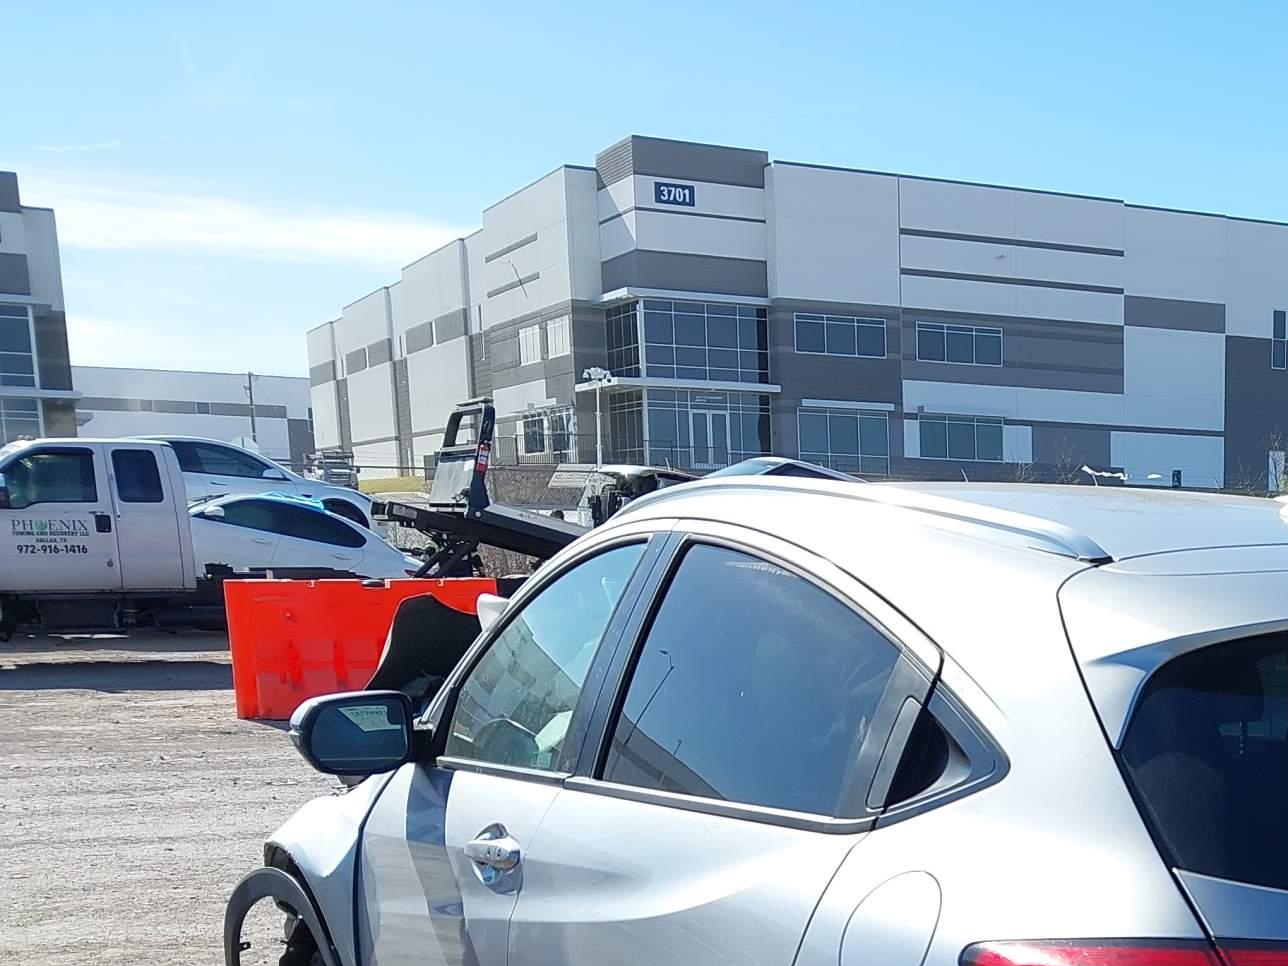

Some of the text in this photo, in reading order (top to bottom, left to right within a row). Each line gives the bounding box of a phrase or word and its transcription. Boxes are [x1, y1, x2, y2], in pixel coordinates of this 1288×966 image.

[660, 186, 690, 203] 3701
[11, 519, 89, 531] PHOENIX
[16, 544, 88, 554] 972-916-1416
